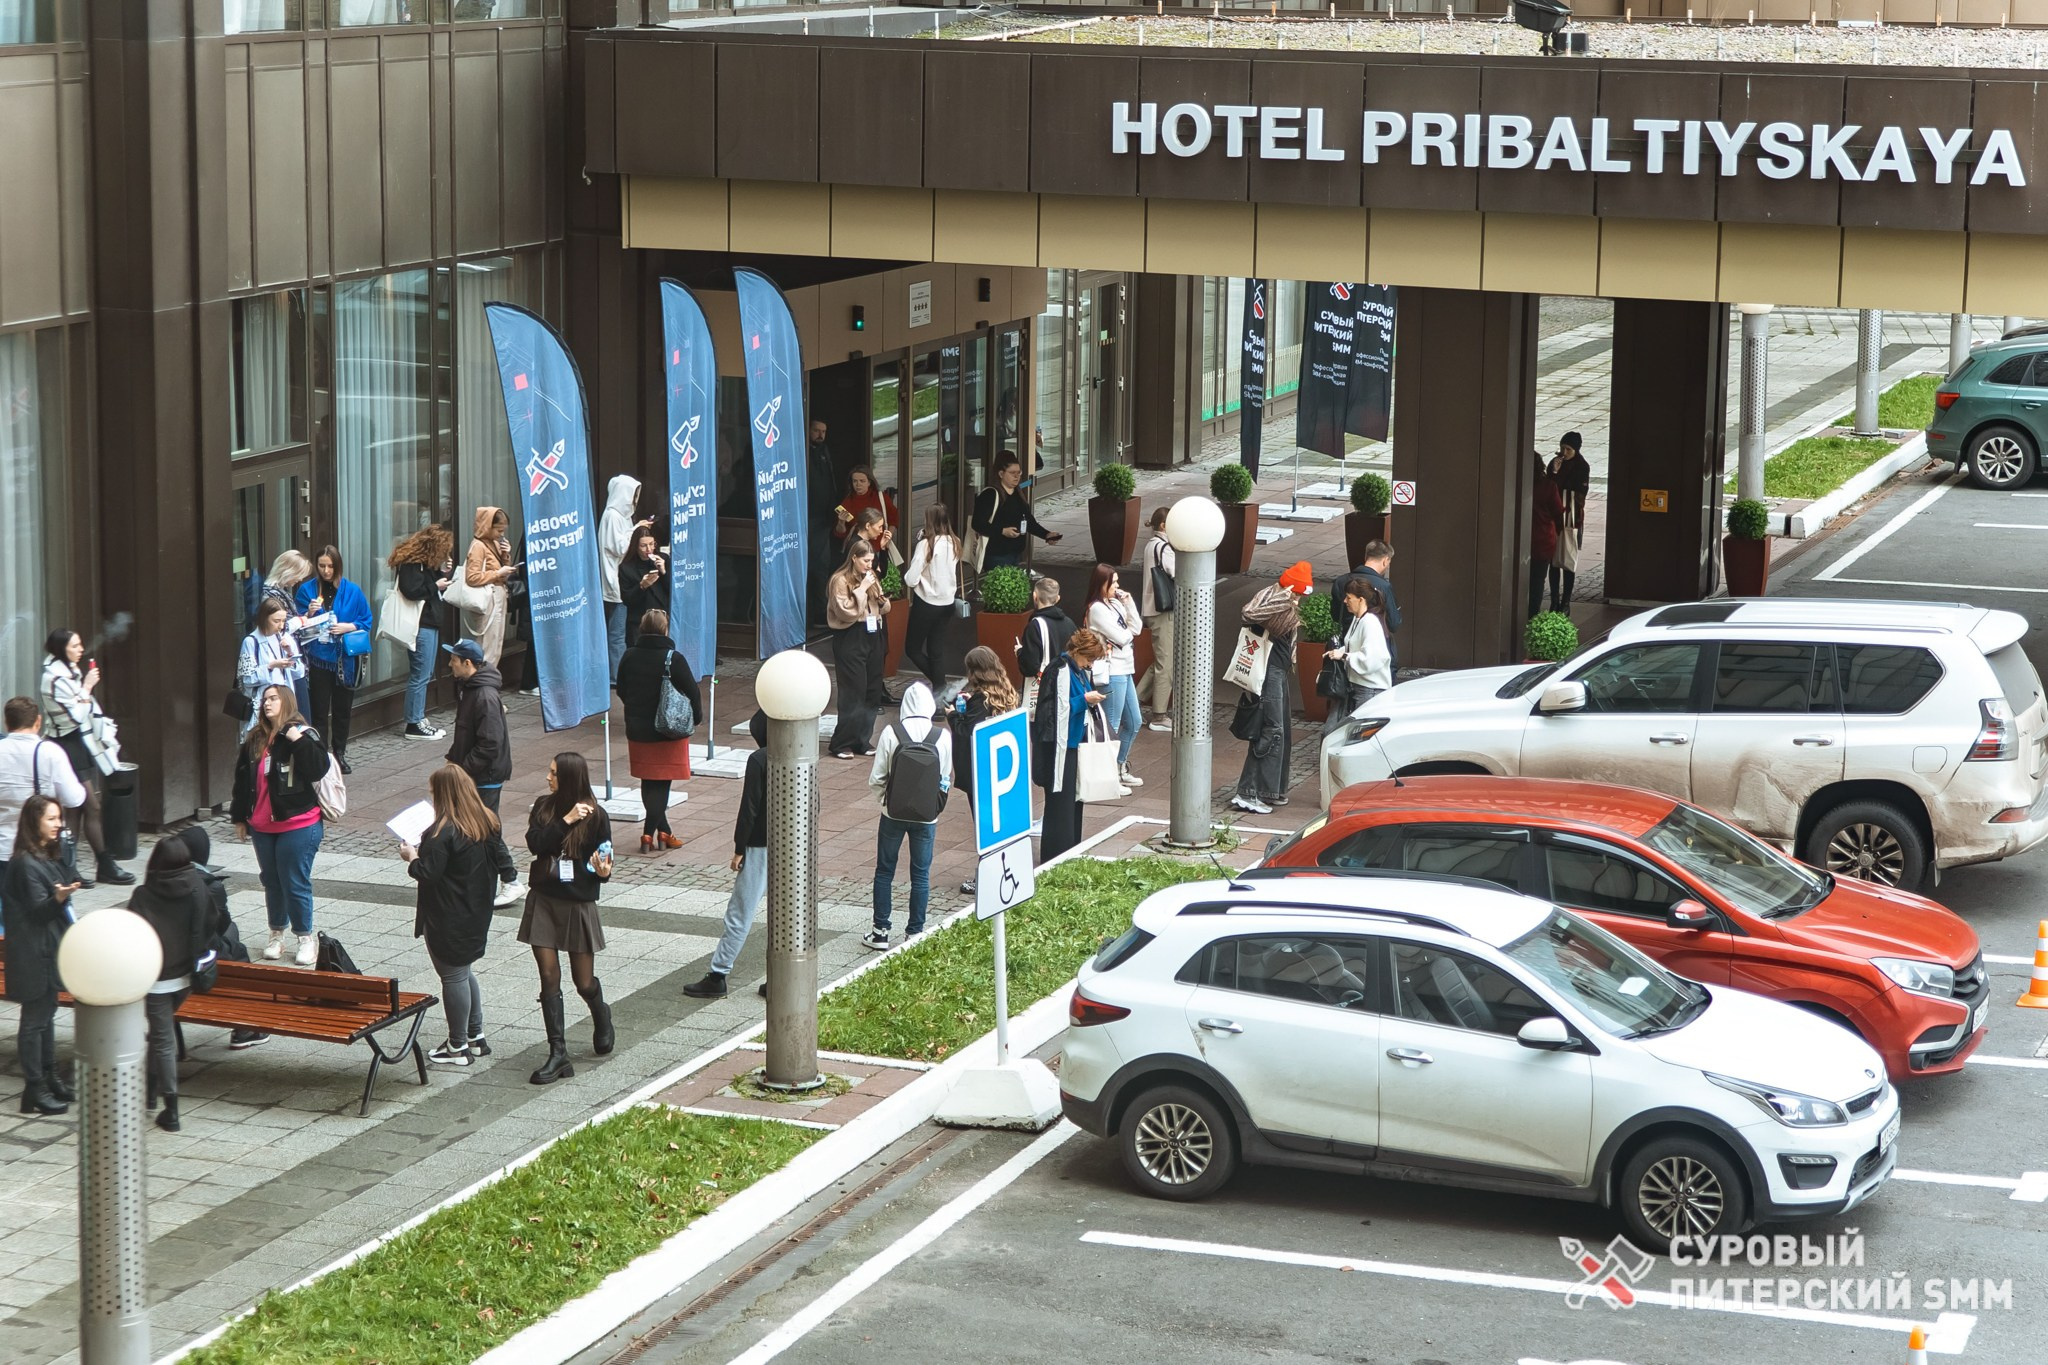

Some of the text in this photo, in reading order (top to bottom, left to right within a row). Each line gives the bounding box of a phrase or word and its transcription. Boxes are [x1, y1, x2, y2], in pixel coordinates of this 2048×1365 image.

[1111, 101, 2027, 188] HOTEL PRIBALTIYSKAYA
[989, 730, 1020, 834] P
